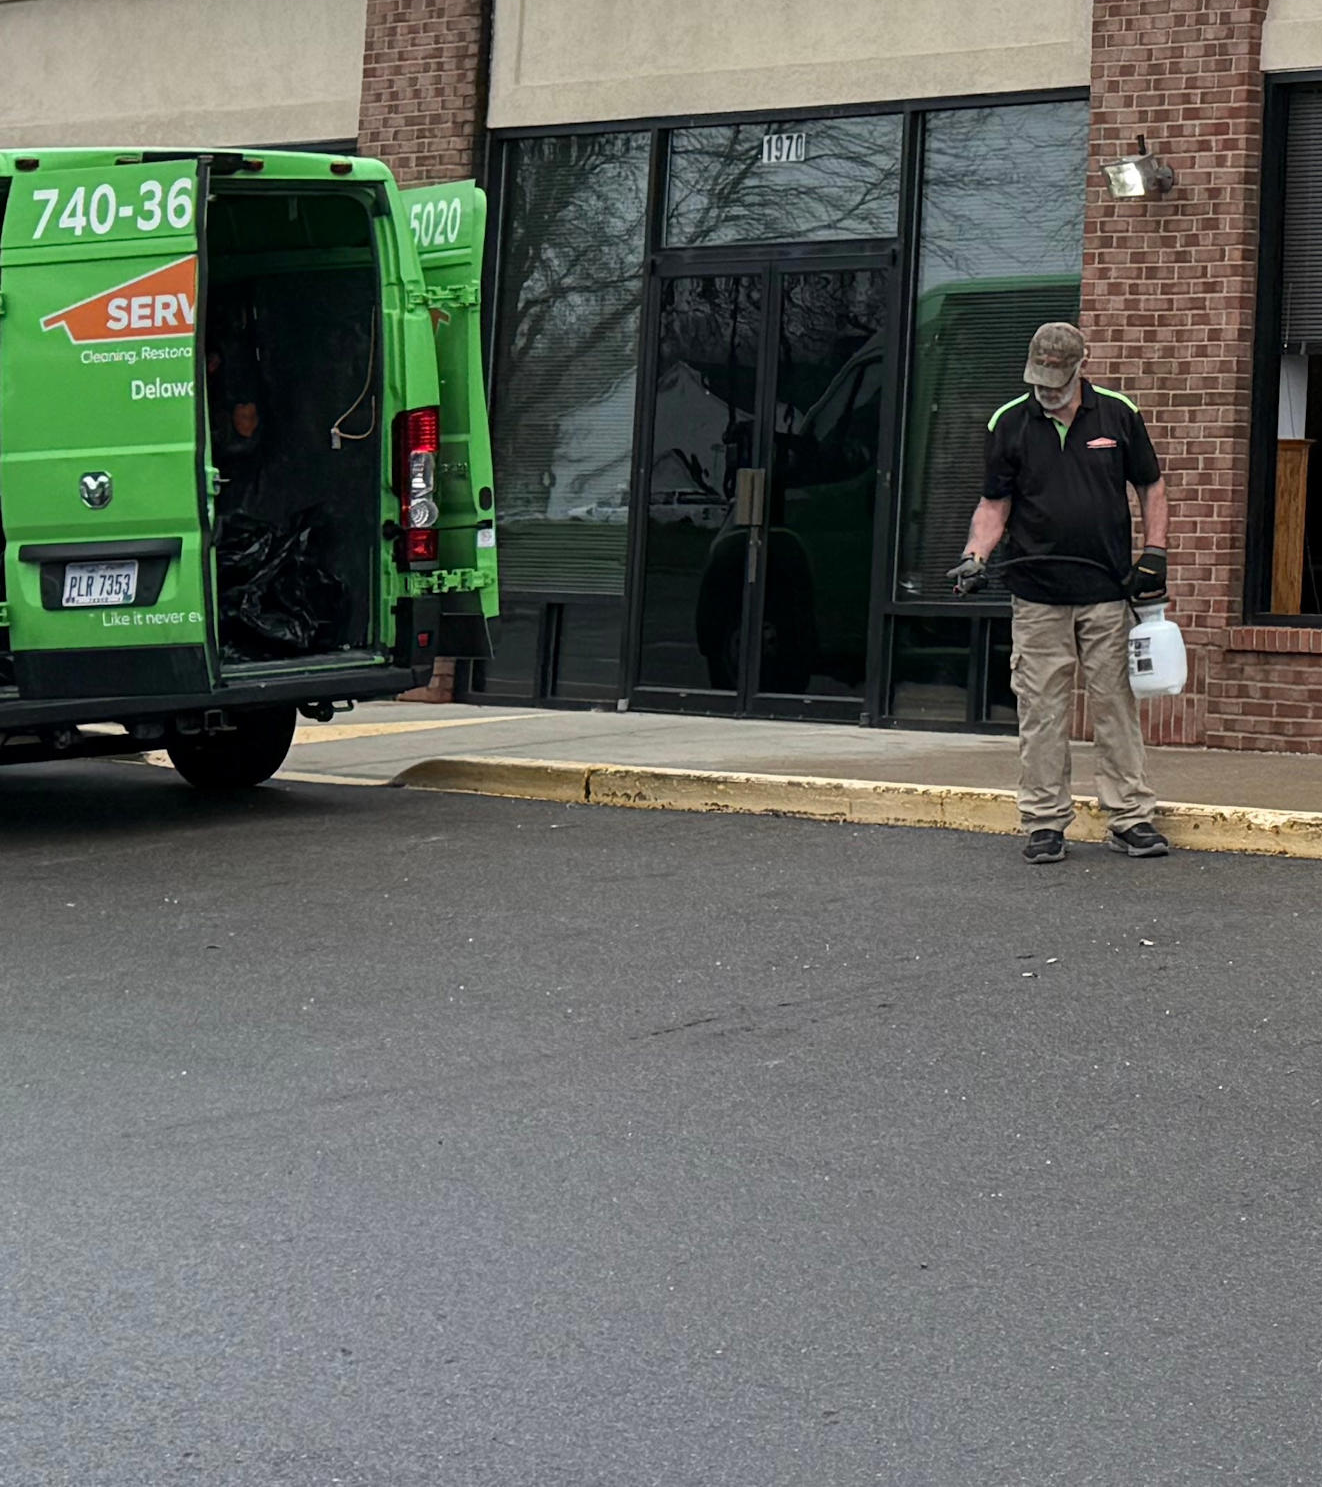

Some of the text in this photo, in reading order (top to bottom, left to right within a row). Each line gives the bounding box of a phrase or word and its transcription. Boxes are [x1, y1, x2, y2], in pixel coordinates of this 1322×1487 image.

[765, 134, 804, 162] 1970
[32, 177, 193, 239] 740-36
[410, 197, 461, 247] 5020
[69, 575, 94, 598] PLR
[102, 612, 130, 627] Like
[133, 611, 143, 625] it
[145, 612, 183, 625] never
